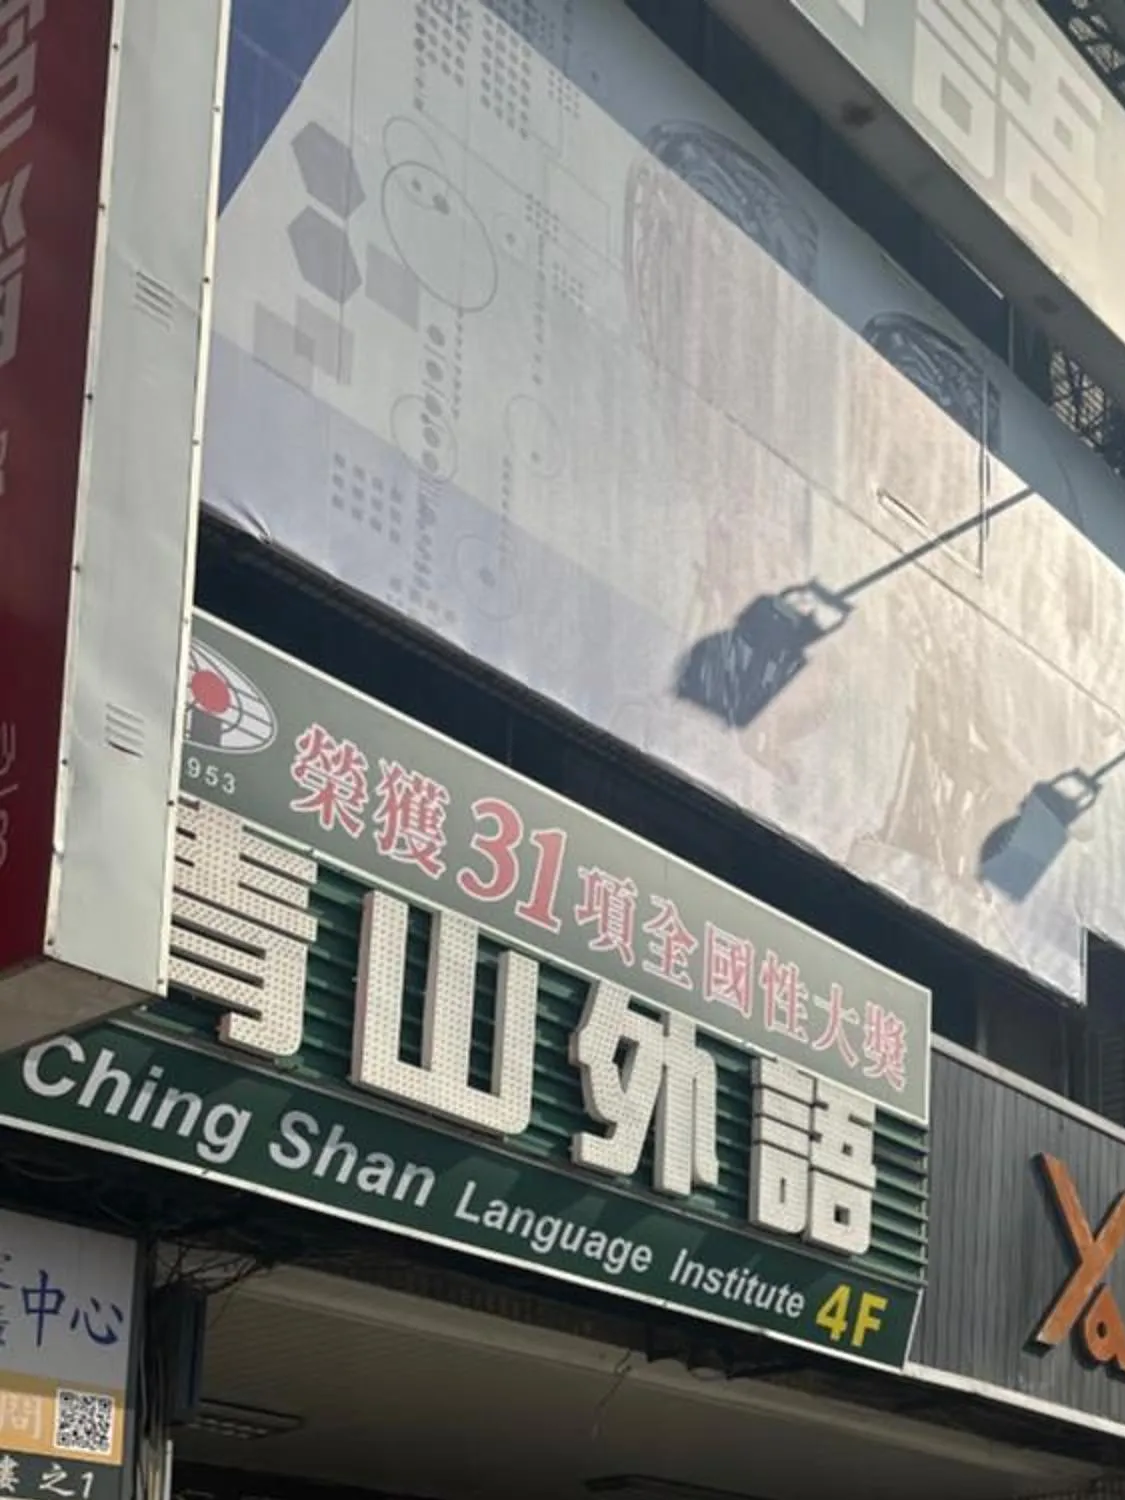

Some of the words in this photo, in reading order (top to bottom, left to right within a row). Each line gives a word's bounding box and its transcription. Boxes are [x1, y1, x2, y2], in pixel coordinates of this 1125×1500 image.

[22, 1033, 250, 1164] Ching
[268, 1107, 435, 1211] Shan
[454, 1180, 655, 1275] Language
[668, 1248, 807, 1321] Institute
[814, 1283, 890, 1348] 4F
[21, 1268, 124, 1348] 中心
